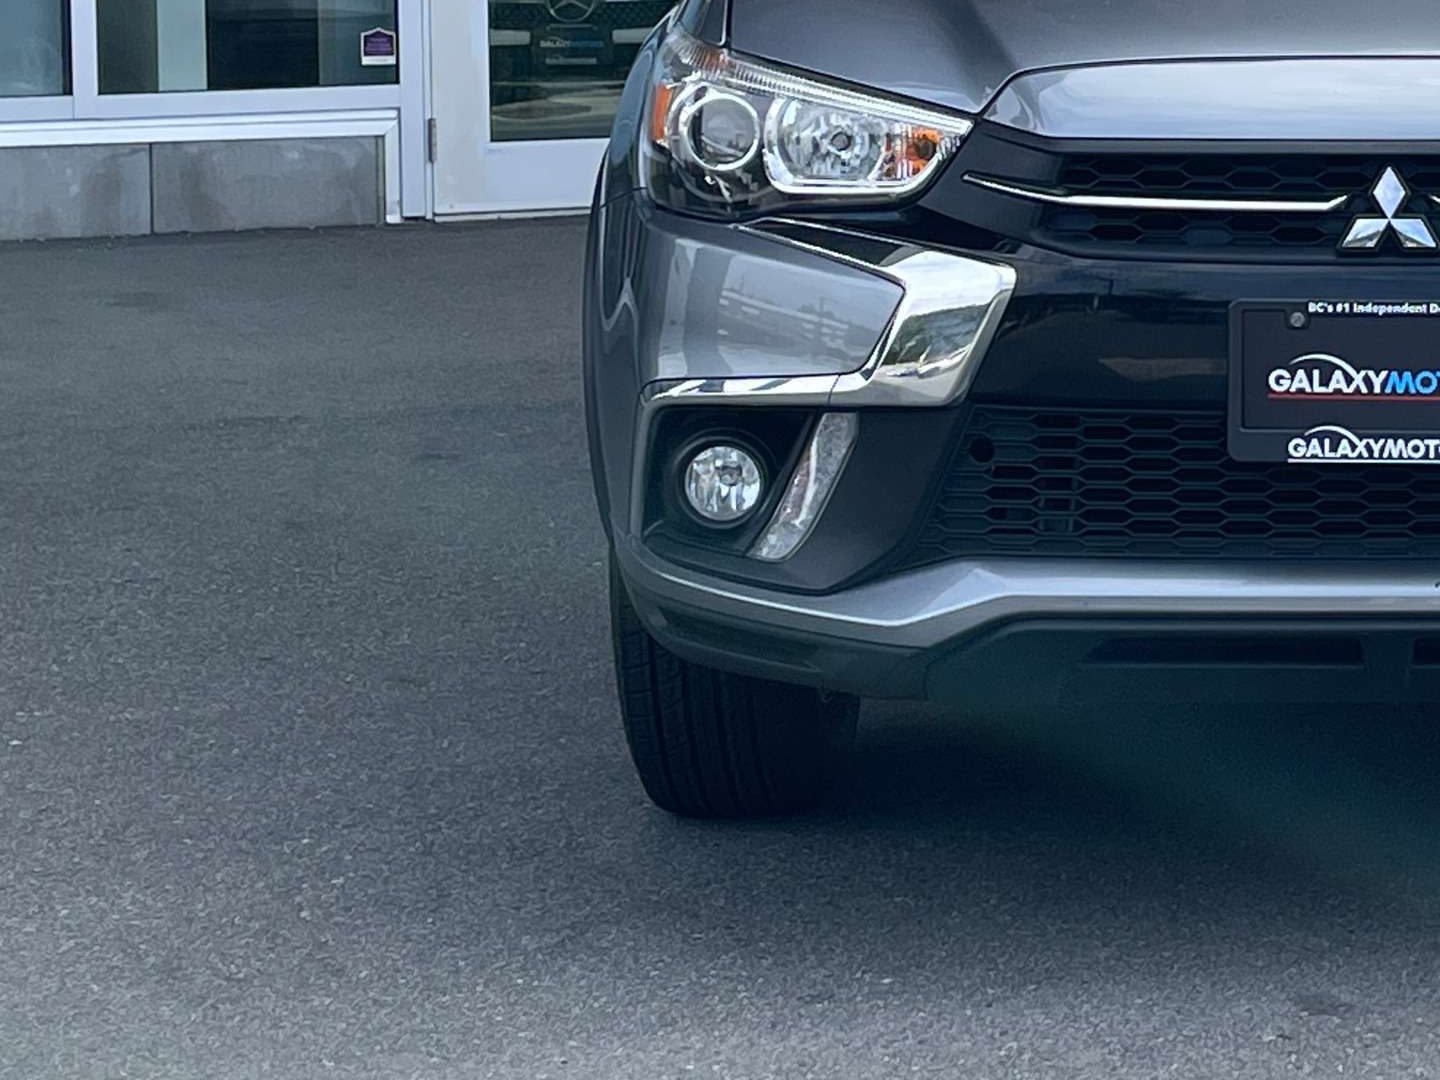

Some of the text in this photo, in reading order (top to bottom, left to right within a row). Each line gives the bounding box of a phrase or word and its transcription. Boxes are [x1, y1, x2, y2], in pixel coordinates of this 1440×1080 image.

[1307, 302, 1334, 313] BC's
[1336, 302, 1350, 313] #1
[1353, 302, 1428, 316] Independent
